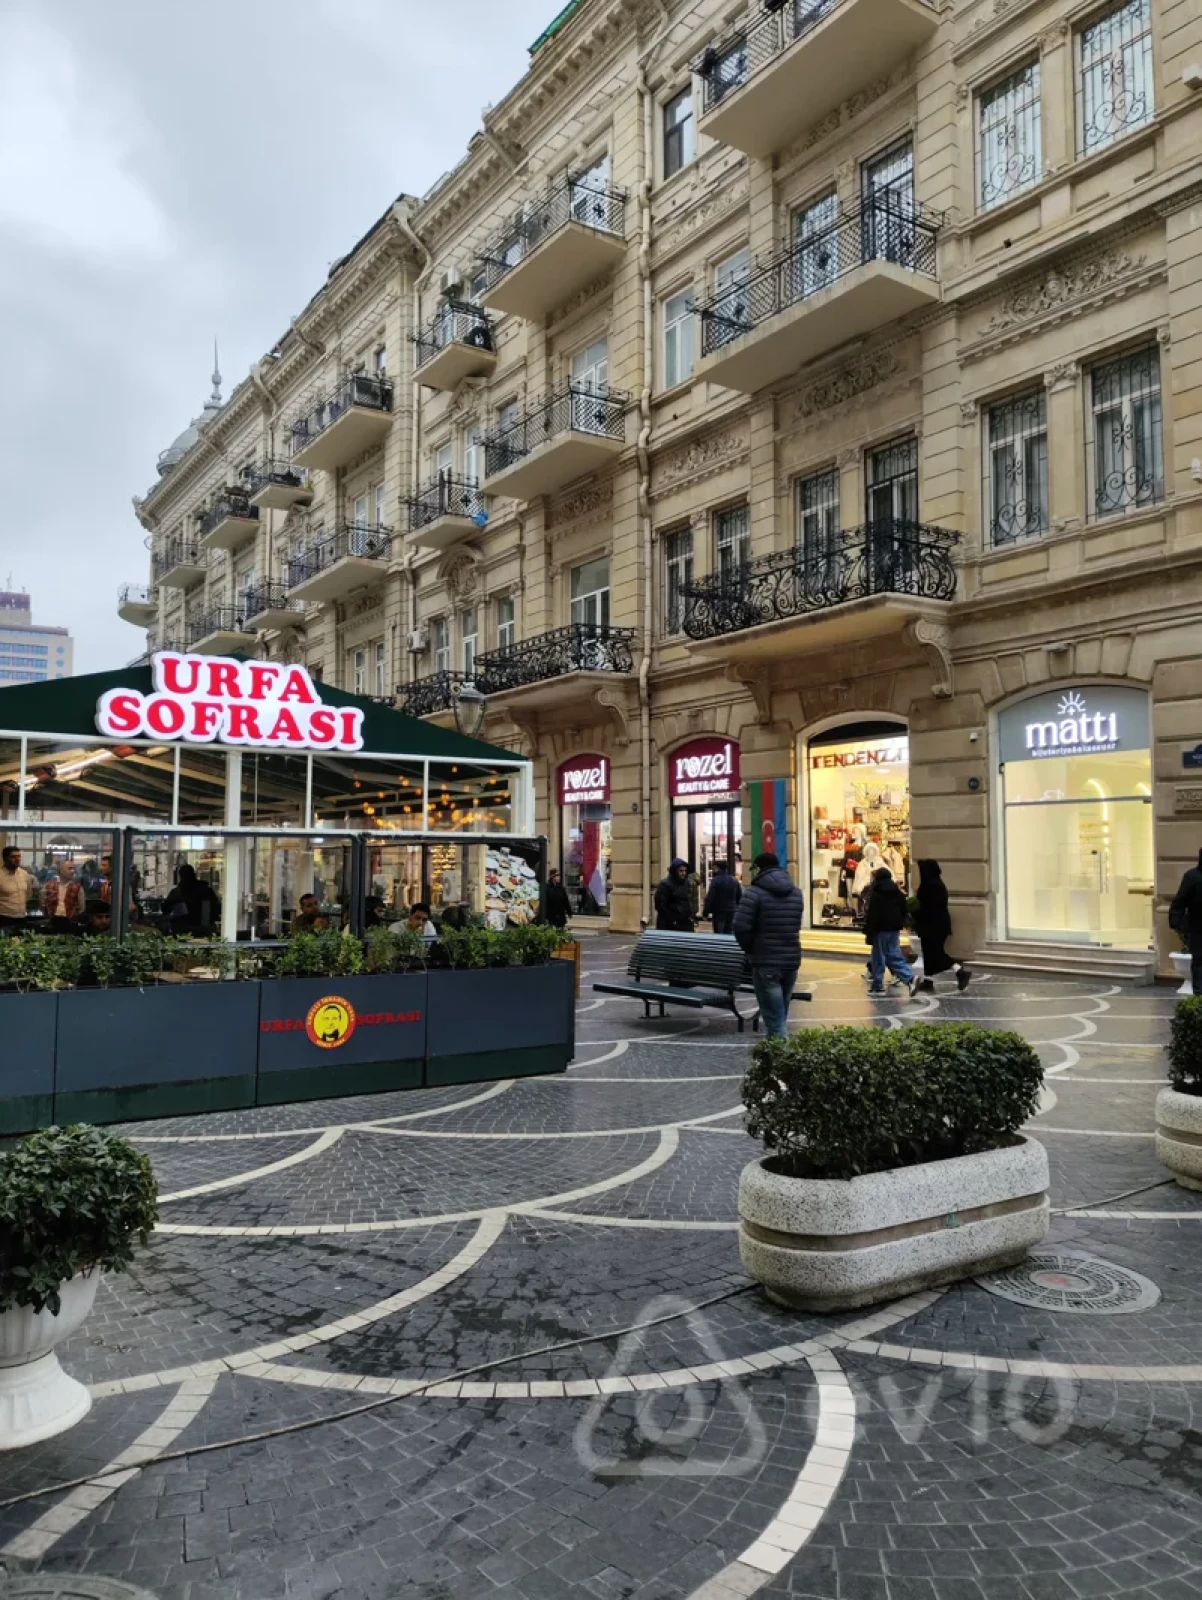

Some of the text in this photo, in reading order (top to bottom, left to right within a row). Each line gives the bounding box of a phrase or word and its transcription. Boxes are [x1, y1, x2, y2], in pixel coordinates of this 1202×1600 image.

[161, 658, 314, 703] URFA
[108, 695, 357, 744] SOFRASI
[563, 760, 606, 790] rozel
[676, 744, 732, 779] rozel
[710, 778, 729, 790] CARE
[260, 1018, 306, 1032] URFA
[356, 1010, 421, 1026] SOFRASI
